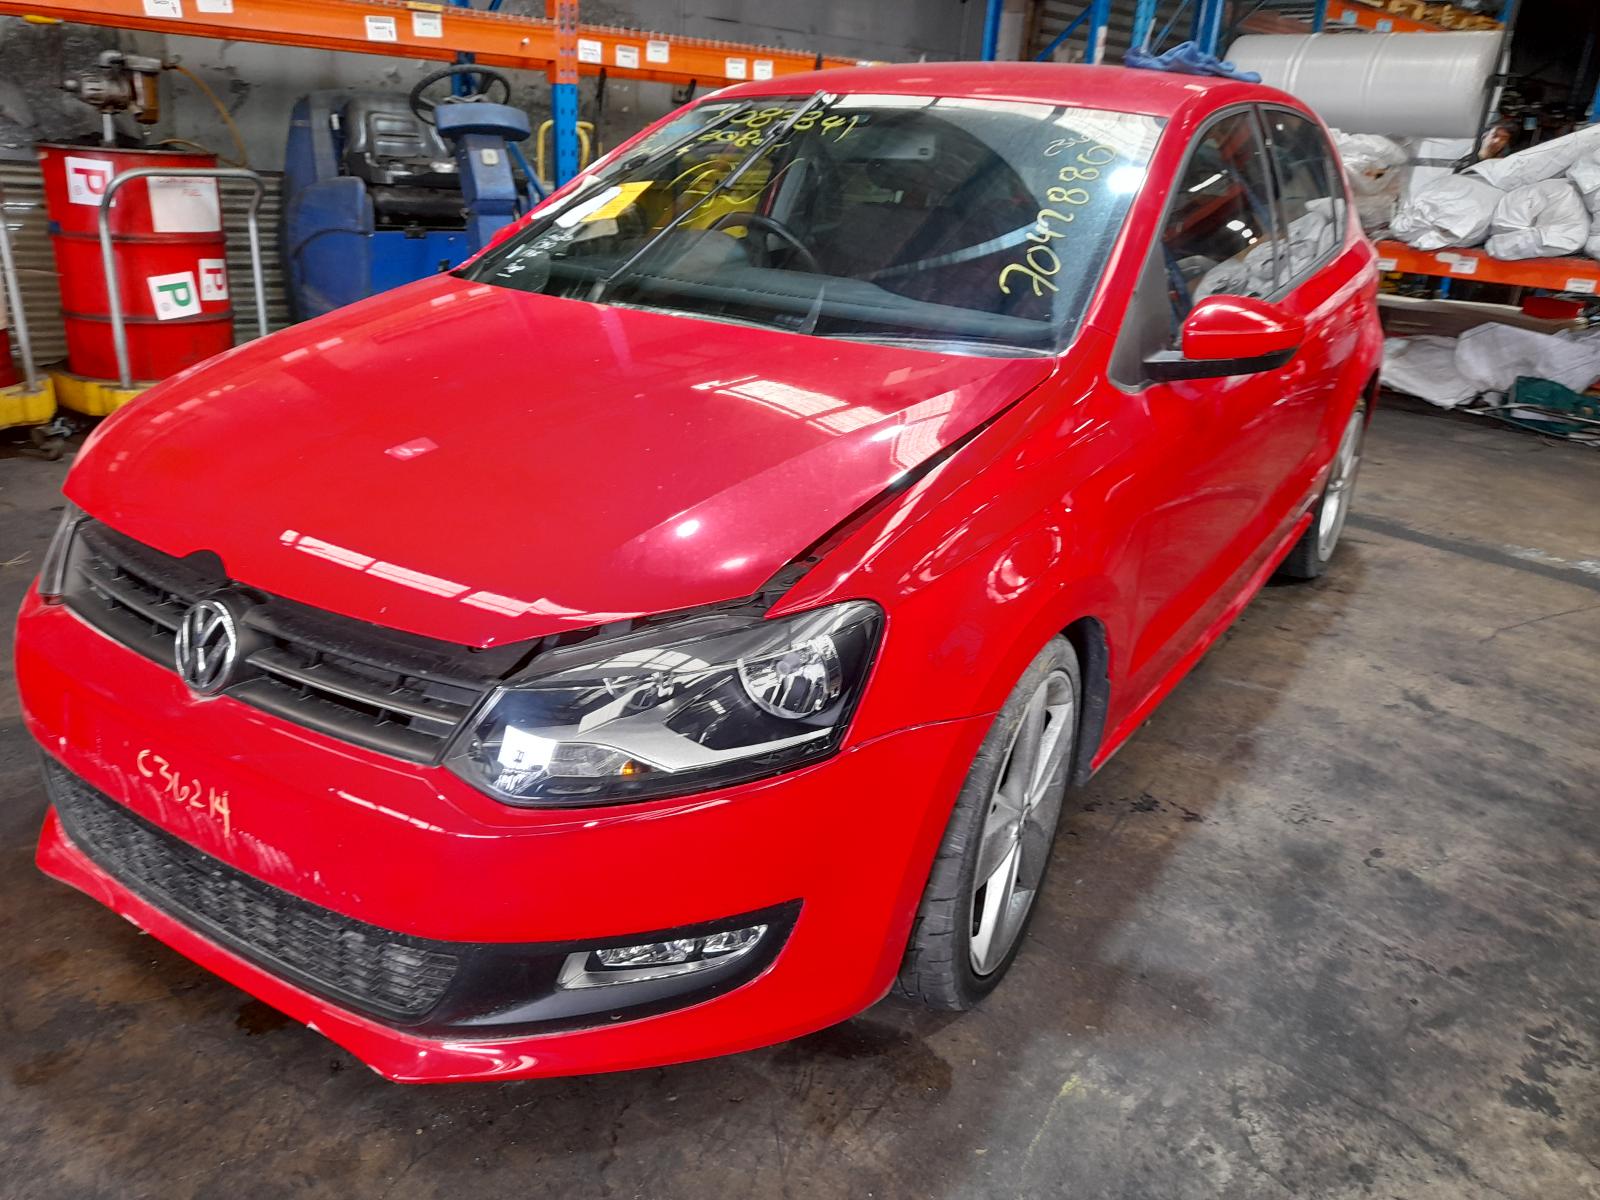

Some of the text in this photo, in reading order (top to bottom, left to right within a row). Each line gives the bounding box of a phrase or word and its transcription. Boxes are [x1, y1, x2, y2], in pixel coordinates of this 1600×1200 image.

[73, 167, 107, 195] P
[204, 268, 223, 291] P
[157, 281, 192, 307] P
